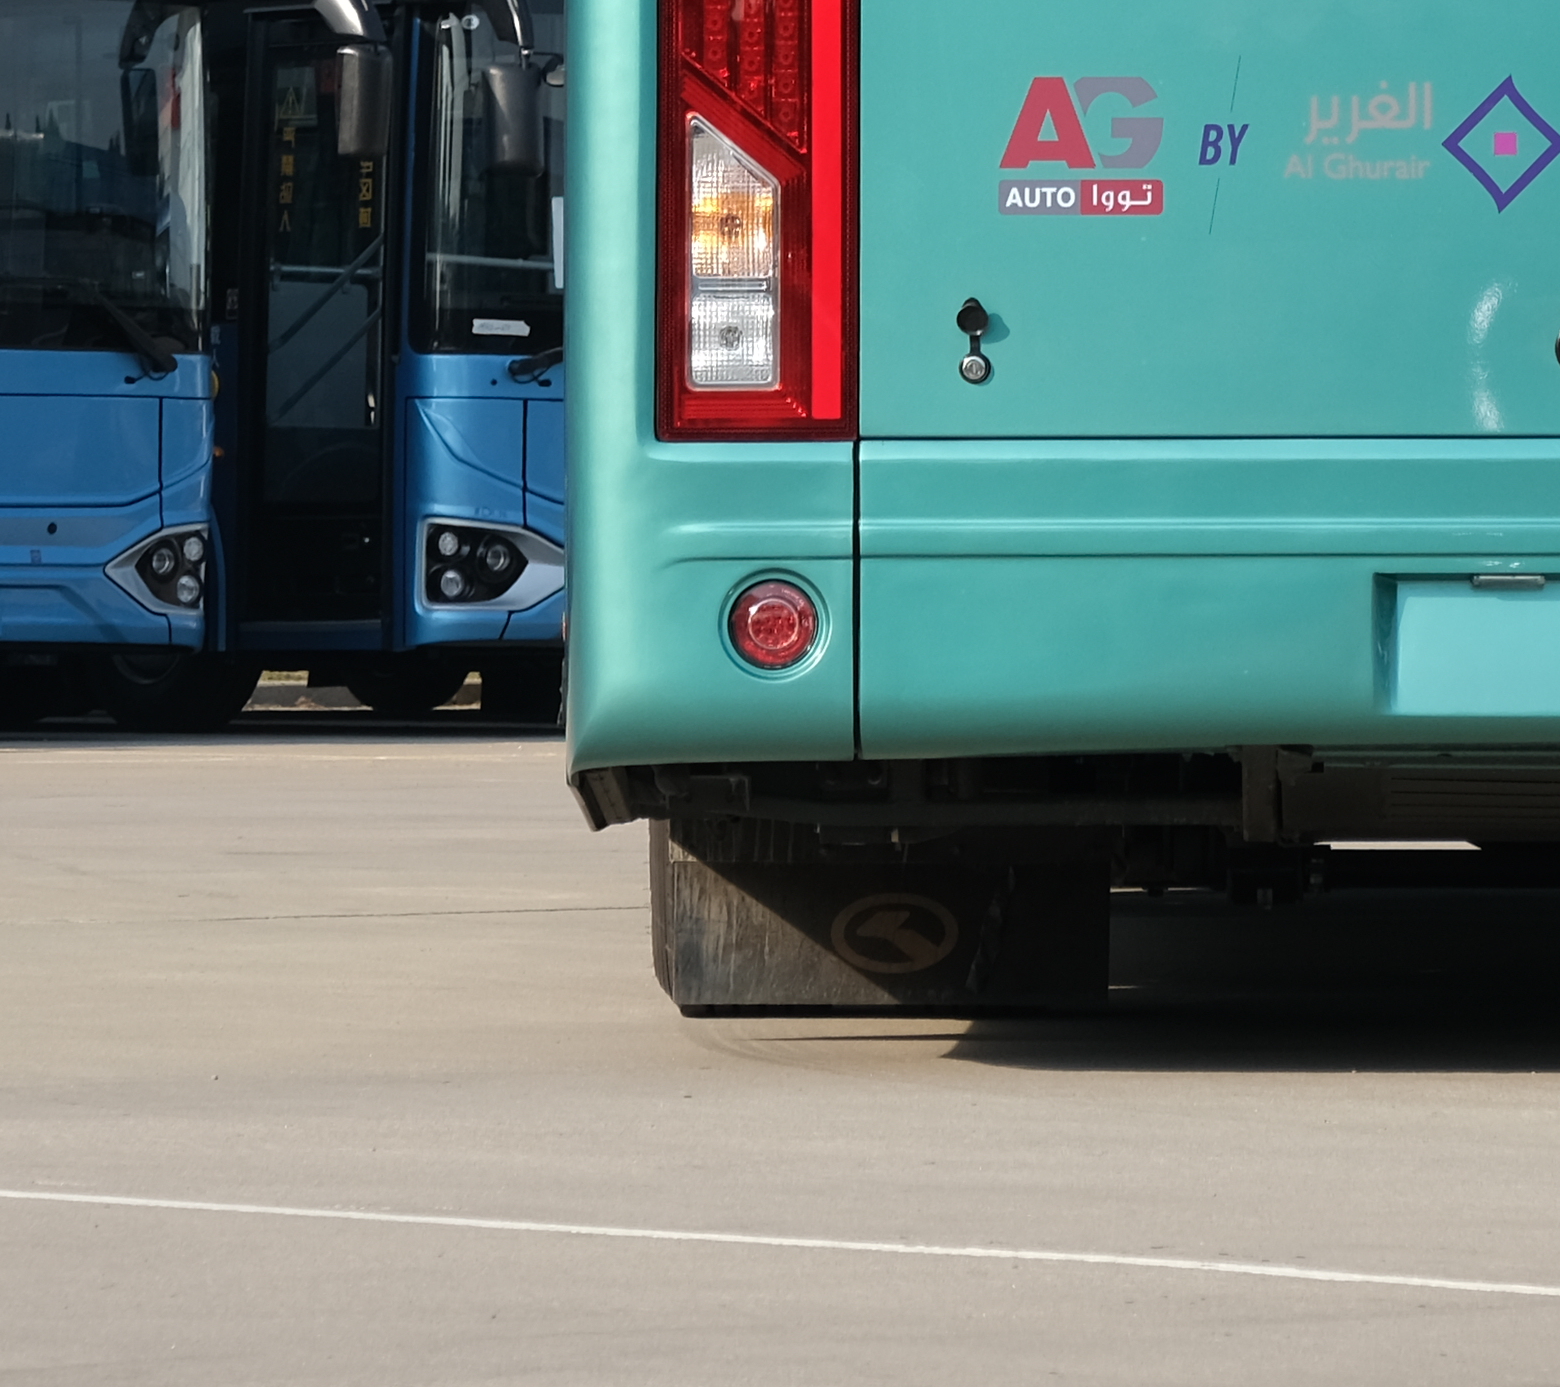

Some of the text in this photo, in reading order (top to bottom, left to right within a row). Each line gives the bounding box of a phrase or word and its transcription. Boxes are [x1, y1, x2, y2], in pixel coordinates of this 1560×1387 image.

[999, 76, 1164, 169] AG
[1304, 80, 1433, 144] الغرير
[1198, 123, 1249, 166] BY
[1284, 152, 1431, 179] Al Ghurair
[1005, 186, 1076, 208] AUTO
